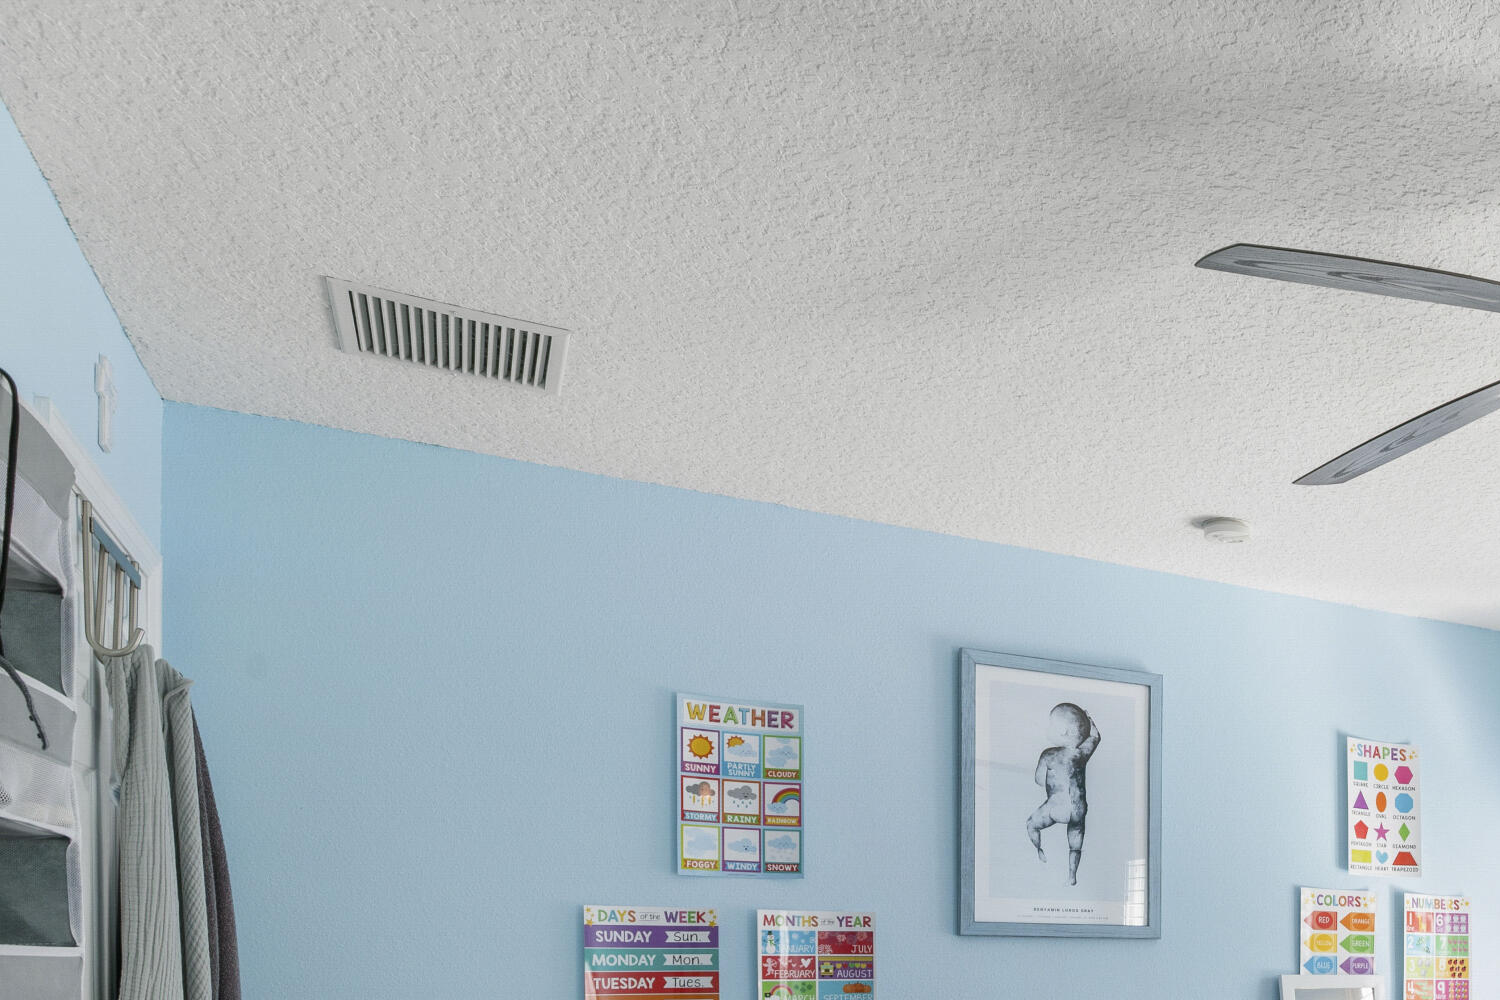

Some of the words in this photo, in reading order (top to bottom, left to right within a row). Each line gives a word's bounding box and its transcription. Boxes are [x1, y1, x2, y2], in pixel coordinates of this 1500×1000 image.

[686, 702, 794, 730] WEATHER
[1357, 743, 1407, 762] SHAPES
[684, 763, 717, 773] SUNNY
[727, 762, 756, 771] PARTLY
[727, 769, 756, 777] SUNNY
[767, 770, 797, 779] CLOUDY
[685, 812, 718, 822] STORMY
[727, 815, 758, 824] RAINY
[686, 860, 716, 869] FOGGY
[727, 861, 758, 870] WINDY
[767, 863, 798, 872] SNOWY
[1316, 894, 1361, 907] COLORS
[1411, 897, 1460, 911] NUMBERS
[597, 909, 636, 923] DAYS
[640, 911, 648, 920] of
[648, 911, 661, 920] the
[664, 910, 706, 924] WEEK
[763, 914, 819, 927] MONTHS
[837, 915, 872, 928] YEAR
[1318, 916, 1330, 924] RED
[1436, 914, 1444, 927] 6
[595, 930, 653, 943] SUNDAY
[851, 944, 873, 953] JULY
[592, 953, 657, 967] MONDAY
[672, 954, 704, 966] Mon.
[774, 969, 816, 978] FEBRUARY
[836, 969, 873, 978] AUGUST
[592, 977, 656, 990] TUESDAY
[673, 977, 705, 988] Tues.
[1407, 981, 1415, 994] 4
[1437, 981, 1446, 994] 9
